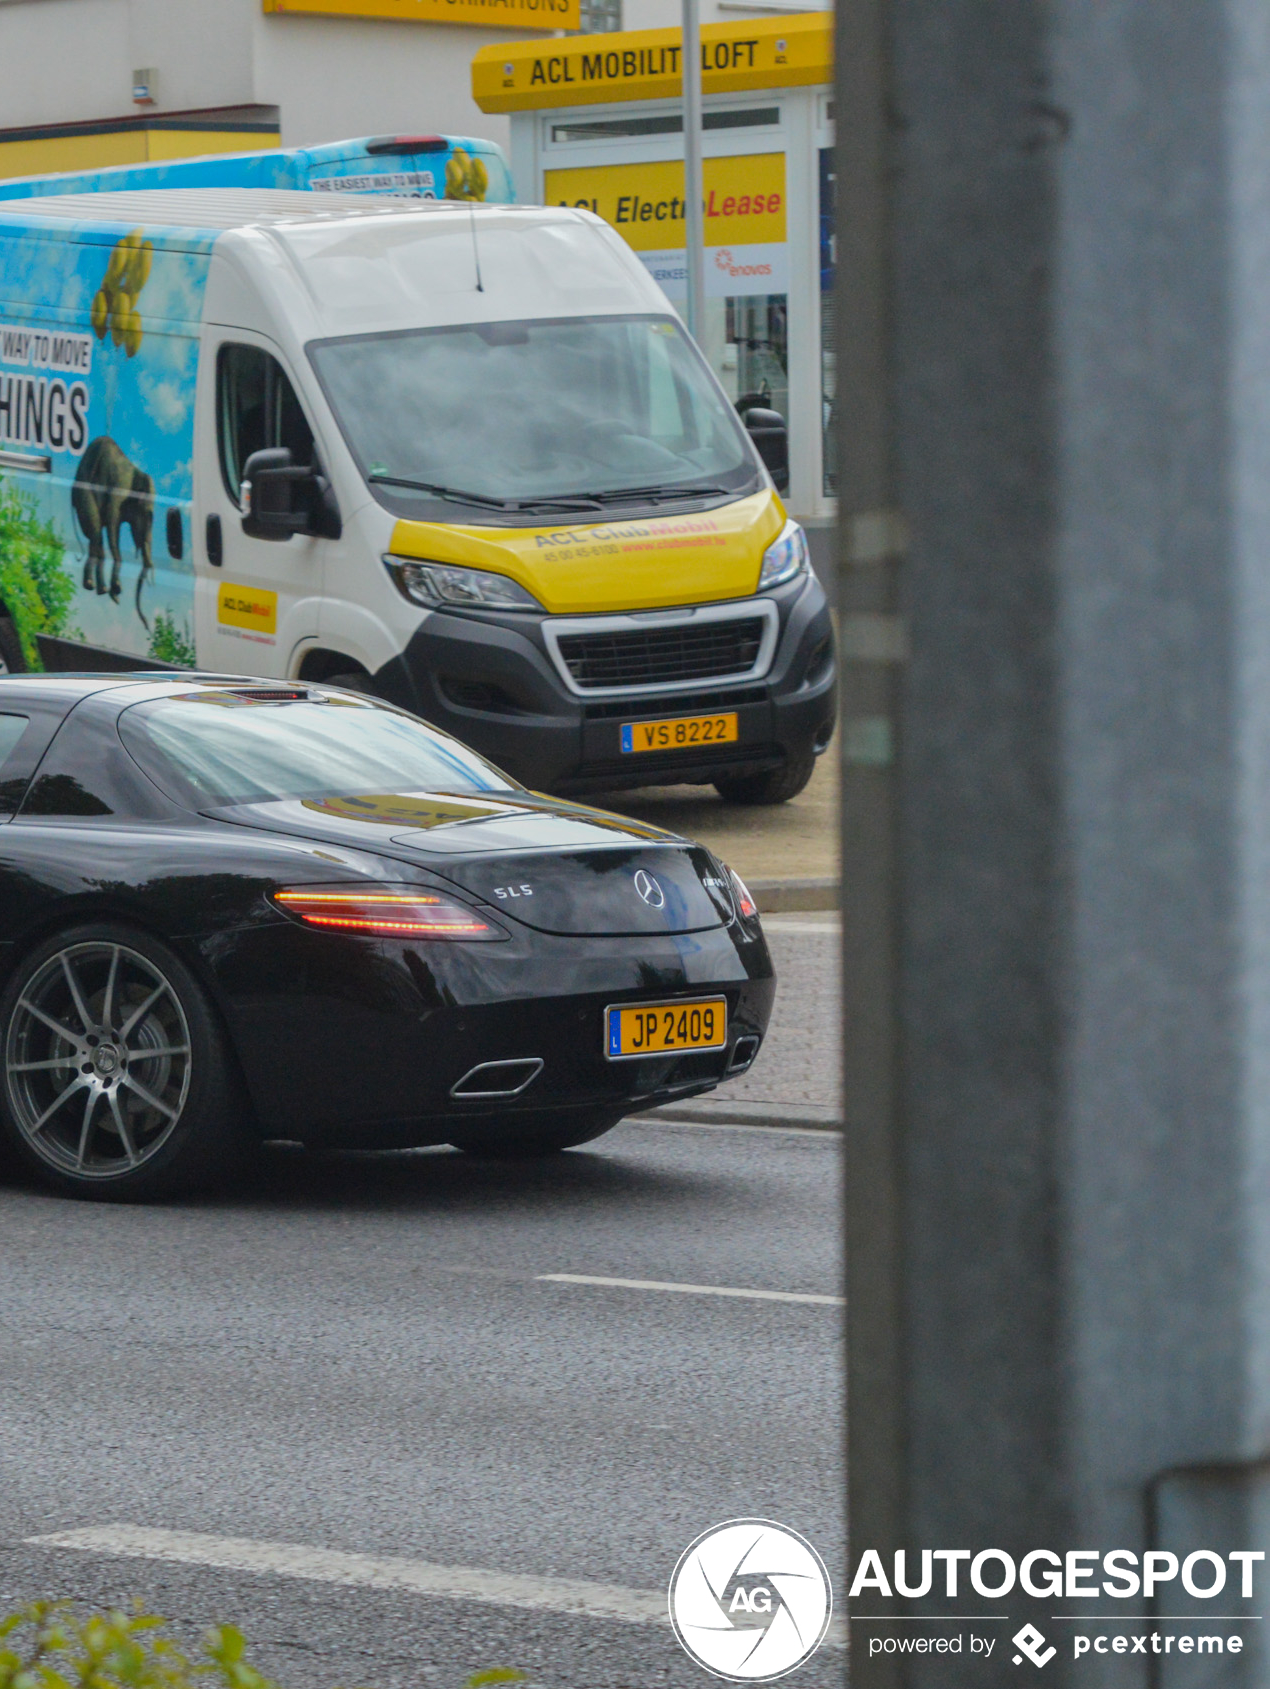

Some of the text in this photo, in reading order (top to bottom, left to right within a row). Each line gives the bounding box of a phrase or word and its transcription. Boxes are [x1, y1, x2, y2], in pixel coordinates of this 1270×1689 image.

[530, 40, 758, 85] ACL MOBILIT LOFT
[730, 263, 772, 277] enovos
[3, 330, 30, 360] WAY
[33, 335, 49, 362] TO
[51, 337, 89, 368] MOVE
[535, 519, 719, 547] ACL ClubMobil
[644, 725, 669, 746] VS
[675, 719, 726, 743] 8222
[494, 885, 533, 899] SLS
[632, 1013, 658, 1047] JP
[663, 1008, 714, 1045] 2409
